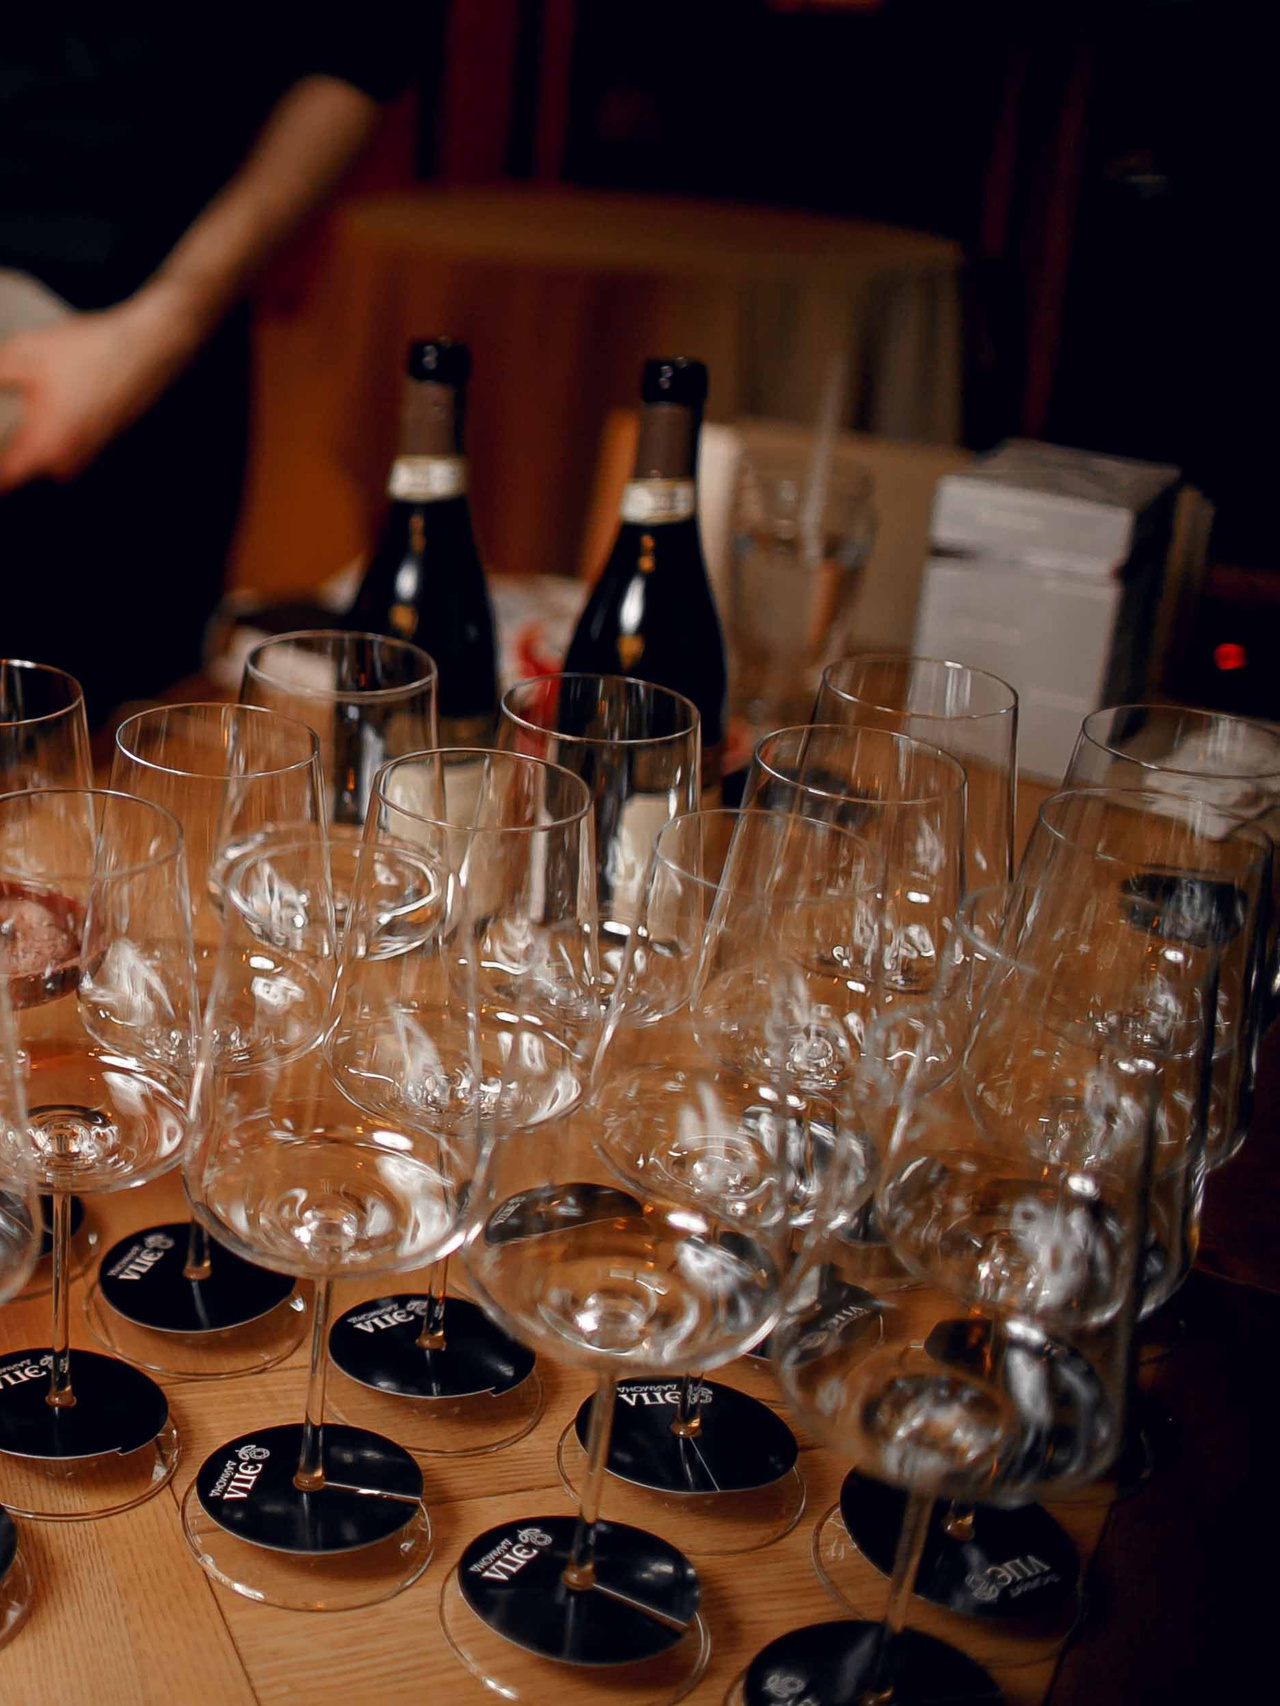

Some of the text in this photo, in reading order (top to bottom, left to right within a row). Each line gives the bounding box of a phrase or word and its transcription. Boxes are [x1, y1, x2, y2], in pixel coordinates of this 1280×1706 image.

[353, 1310, 415, 1334] ЭПЛ
[208, 1460, 237, 1498] ДАЙМОНД
[222, 1461, 263, 1500] ЭПЛ
[481, 1543, 539, 1581] ЭПЛ
